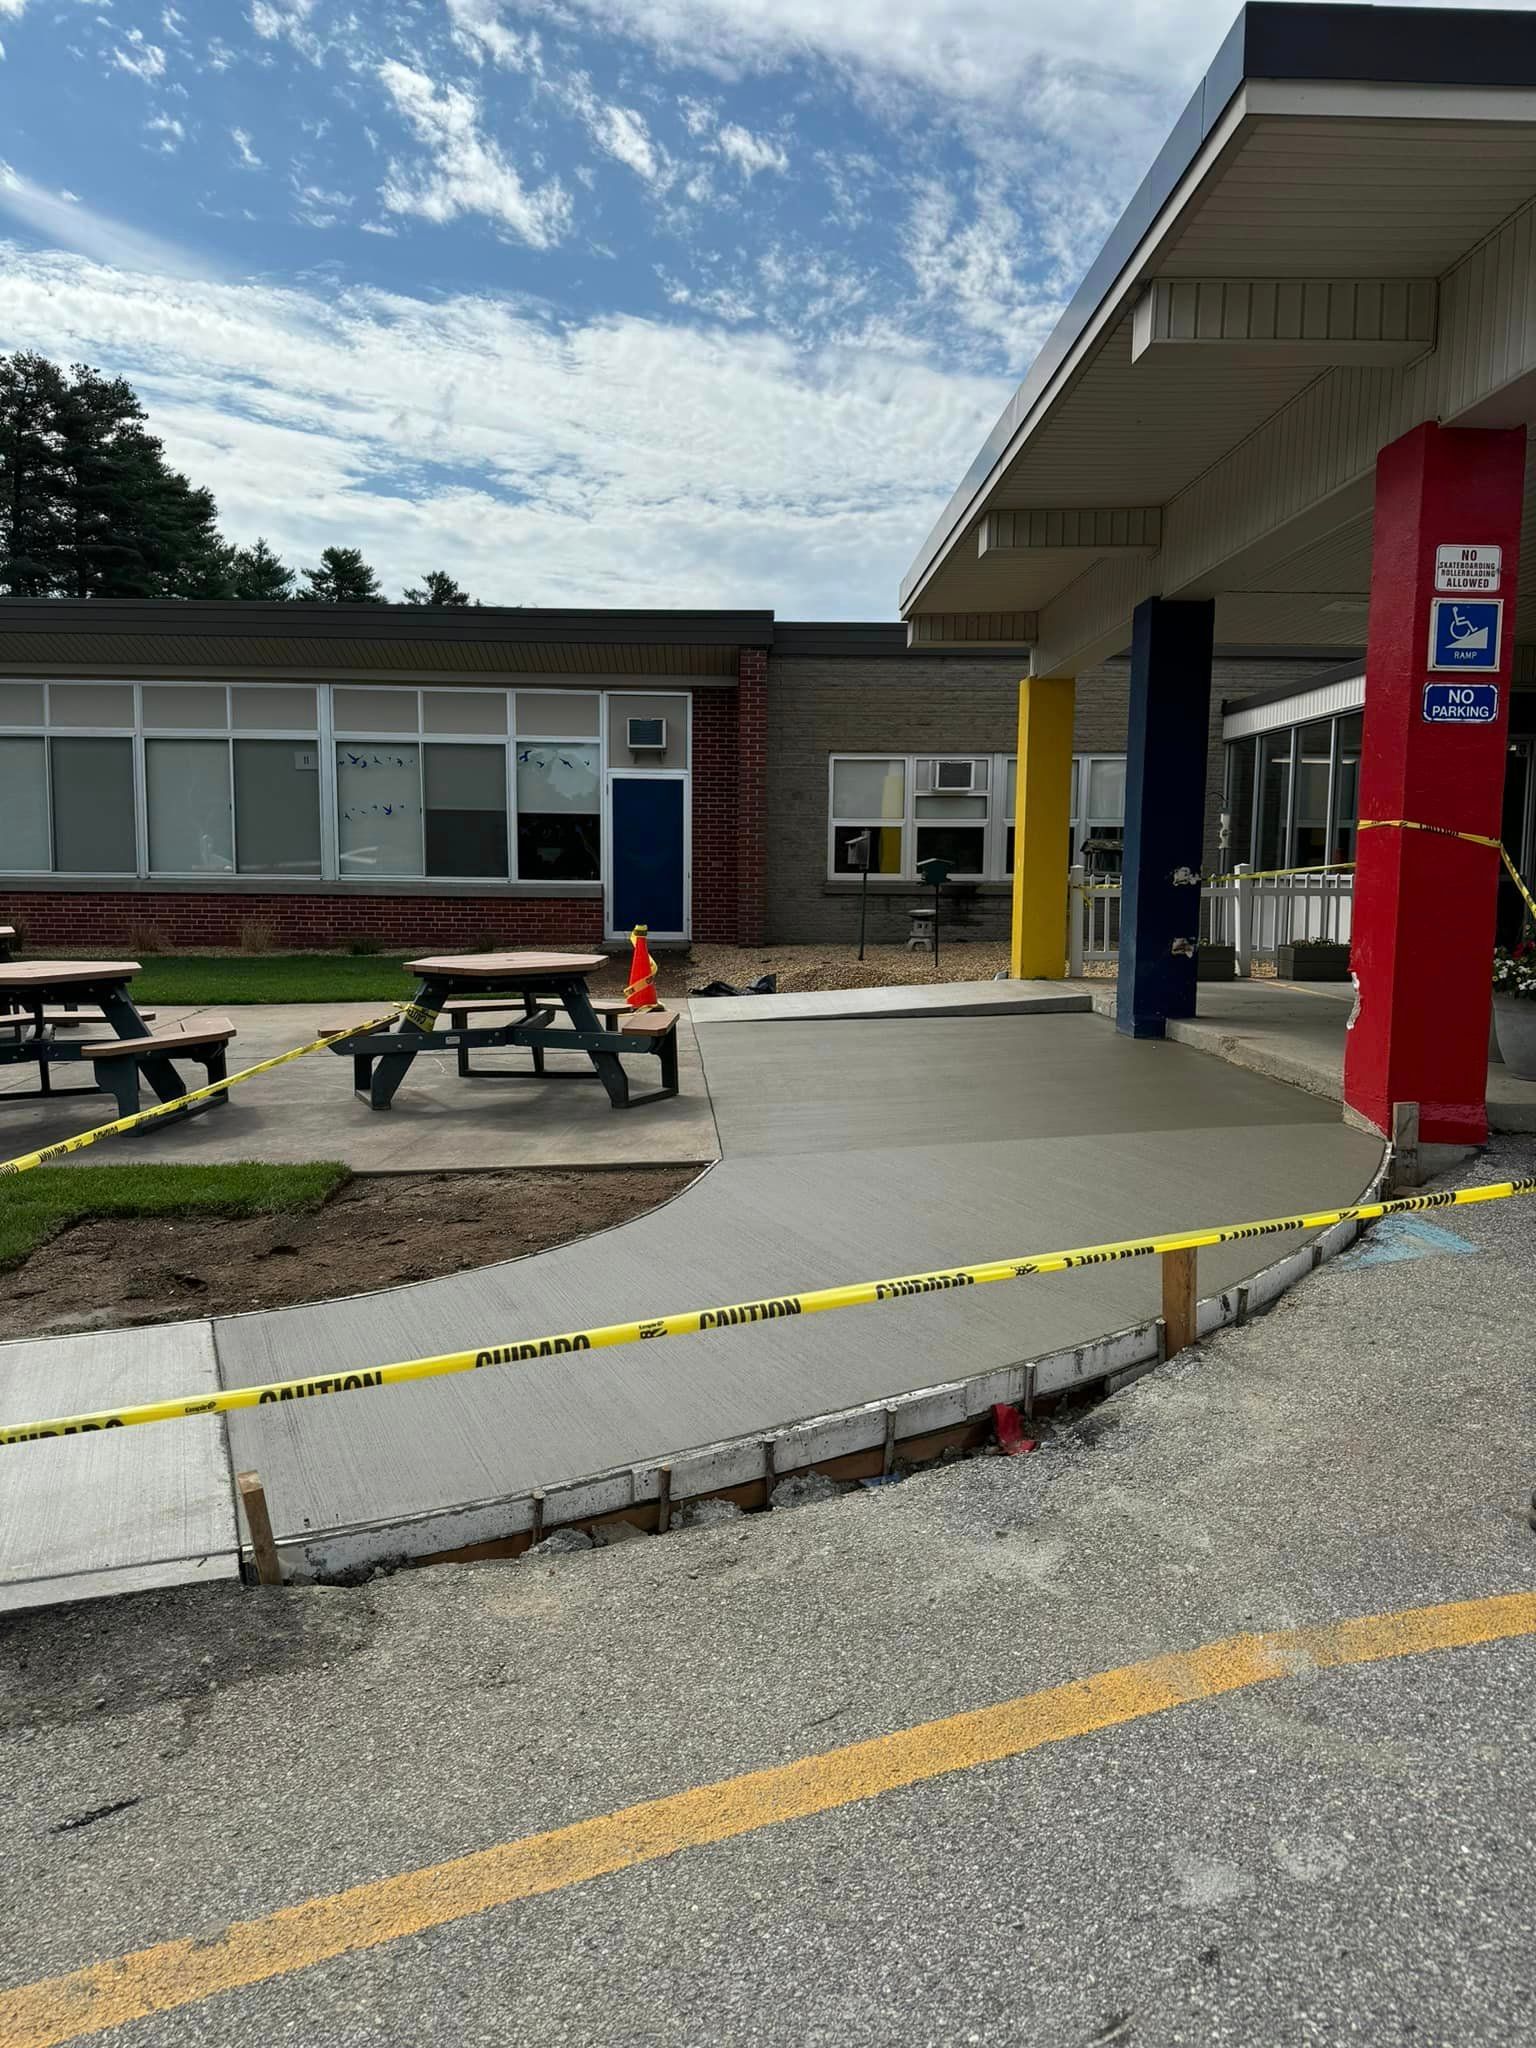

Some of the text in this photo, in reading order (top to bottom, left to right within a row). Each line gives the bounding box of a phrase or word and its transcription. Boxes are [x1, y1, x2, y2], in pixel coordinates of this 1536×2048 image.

[1461, 549, 1478, 562] NO
[1439, 561, 1496, 570] SKATEBOARDING
[1440, 569, 1496, 577] ROLLERBLADING
[1446, 577, 1490, 588] ALLOWED
[1453, 650, 1478, 660] RAMP
[1448, 688, 1475, 705] NO
[1431, 705, 1490, 718] PARKING
[699, 1297, 802, 1330] CAUTION
